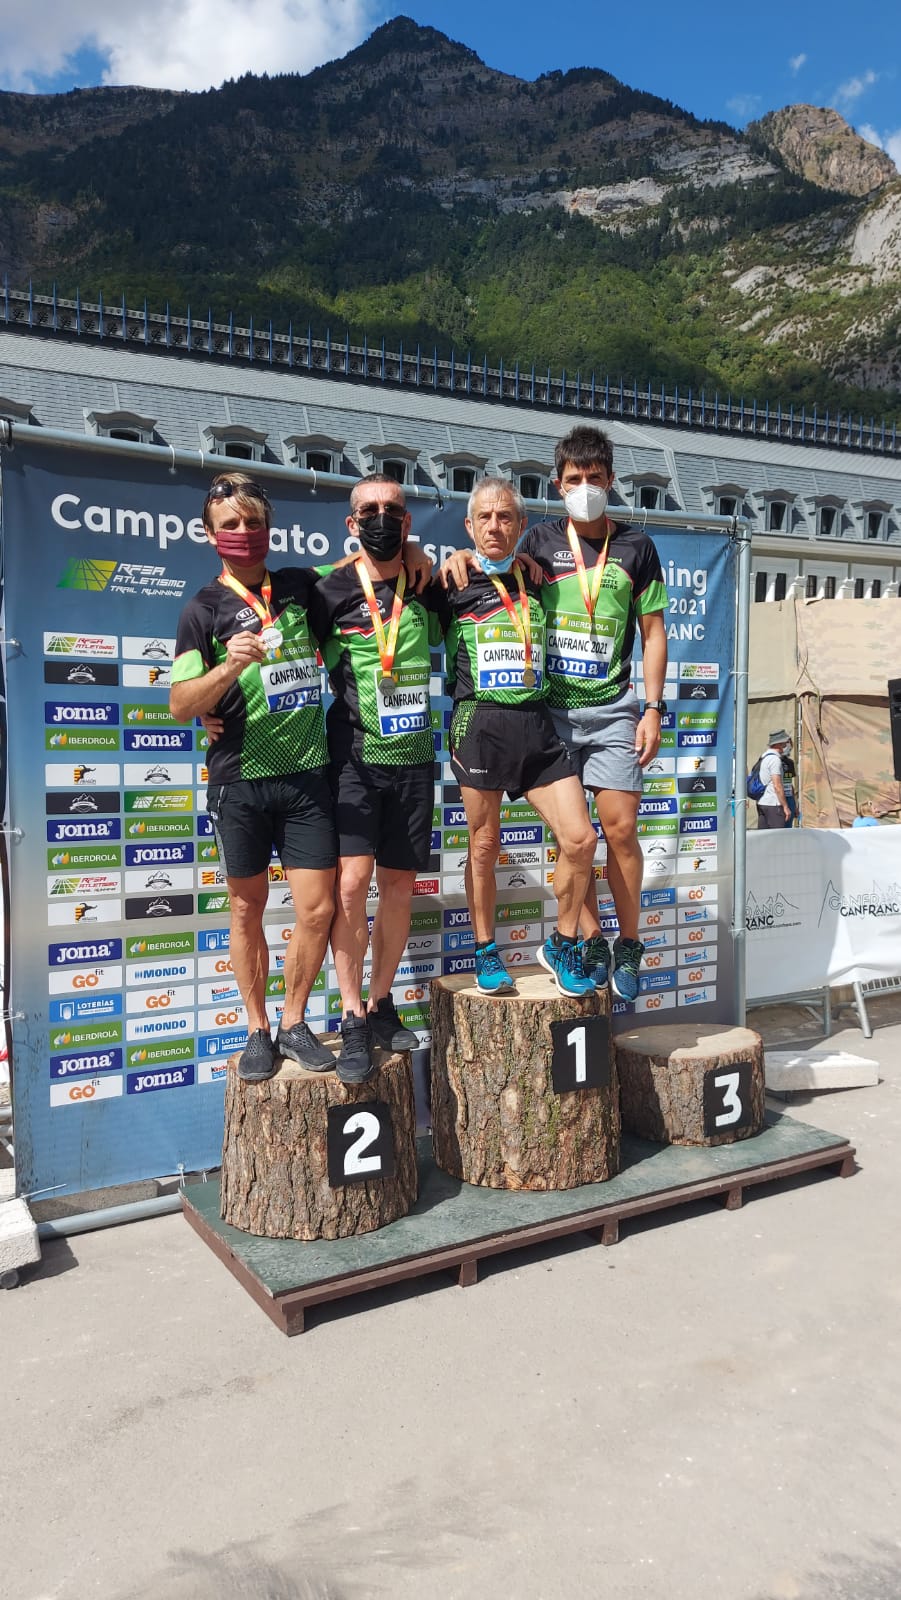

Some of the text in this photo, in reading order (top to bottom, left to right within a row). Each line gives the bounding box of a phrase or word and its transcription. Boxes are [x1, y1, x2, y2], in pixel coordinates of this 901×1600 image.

[113, 575, 187, 588] ATLETISMO
[110, 585, 184, 597] TRAIL RUNNING
[669, 597, 706, 615] 2021
[549, 635, 608, 654] CANFRANC 2021
[269, 667, 310, 686] CANFRANC
[383, 692, 422, 708] CANFRANC
[68, 737, 116, 745] IBERDROLA
[146, 824, 190, 832] IBERDROLA
[70, 853, 117, 863] IBERDROLA
[688, 890, 703, 899] GO
[840, 902, 900, 917] CANFRANC
[646, 914, 661, 925] GO
[510, 929, 527, 941] GO
[688, 931, 703, 941] GO
[147, 940, 191, 950] IBERDROLA
[407, 941, 433, 950] DJO
[646, 956, 661, 967] GO
[143, 966, 187, 978] MONDO
[401, 964, 435, 975] MONDO
[72, 974, 99, 988] GO
[688, 971, 703, 981] GO
[145, 989, 176, 1008] GO fit
[404, 988, 425, 1001] GO
[77, 999, 114, 1009] LOTERÍAS
[646, 998, 661, 1009] GO
[215, 1011, 239, 1025] GO
[143, 1019, 187, 1033] MONDO
[72, 1030, 119, 1042] IBERDROLA
[221, 1035, 249, 1044] LOTERÍA
[147, 1047, 191, 1058] IBERDROLA
[566, 1026, 587, 1083] 1
[69, 1079, 100, 1100] GO fit
[714, 1072, 741, 1127] 3
[342, 1111, 382, 1176] 2
